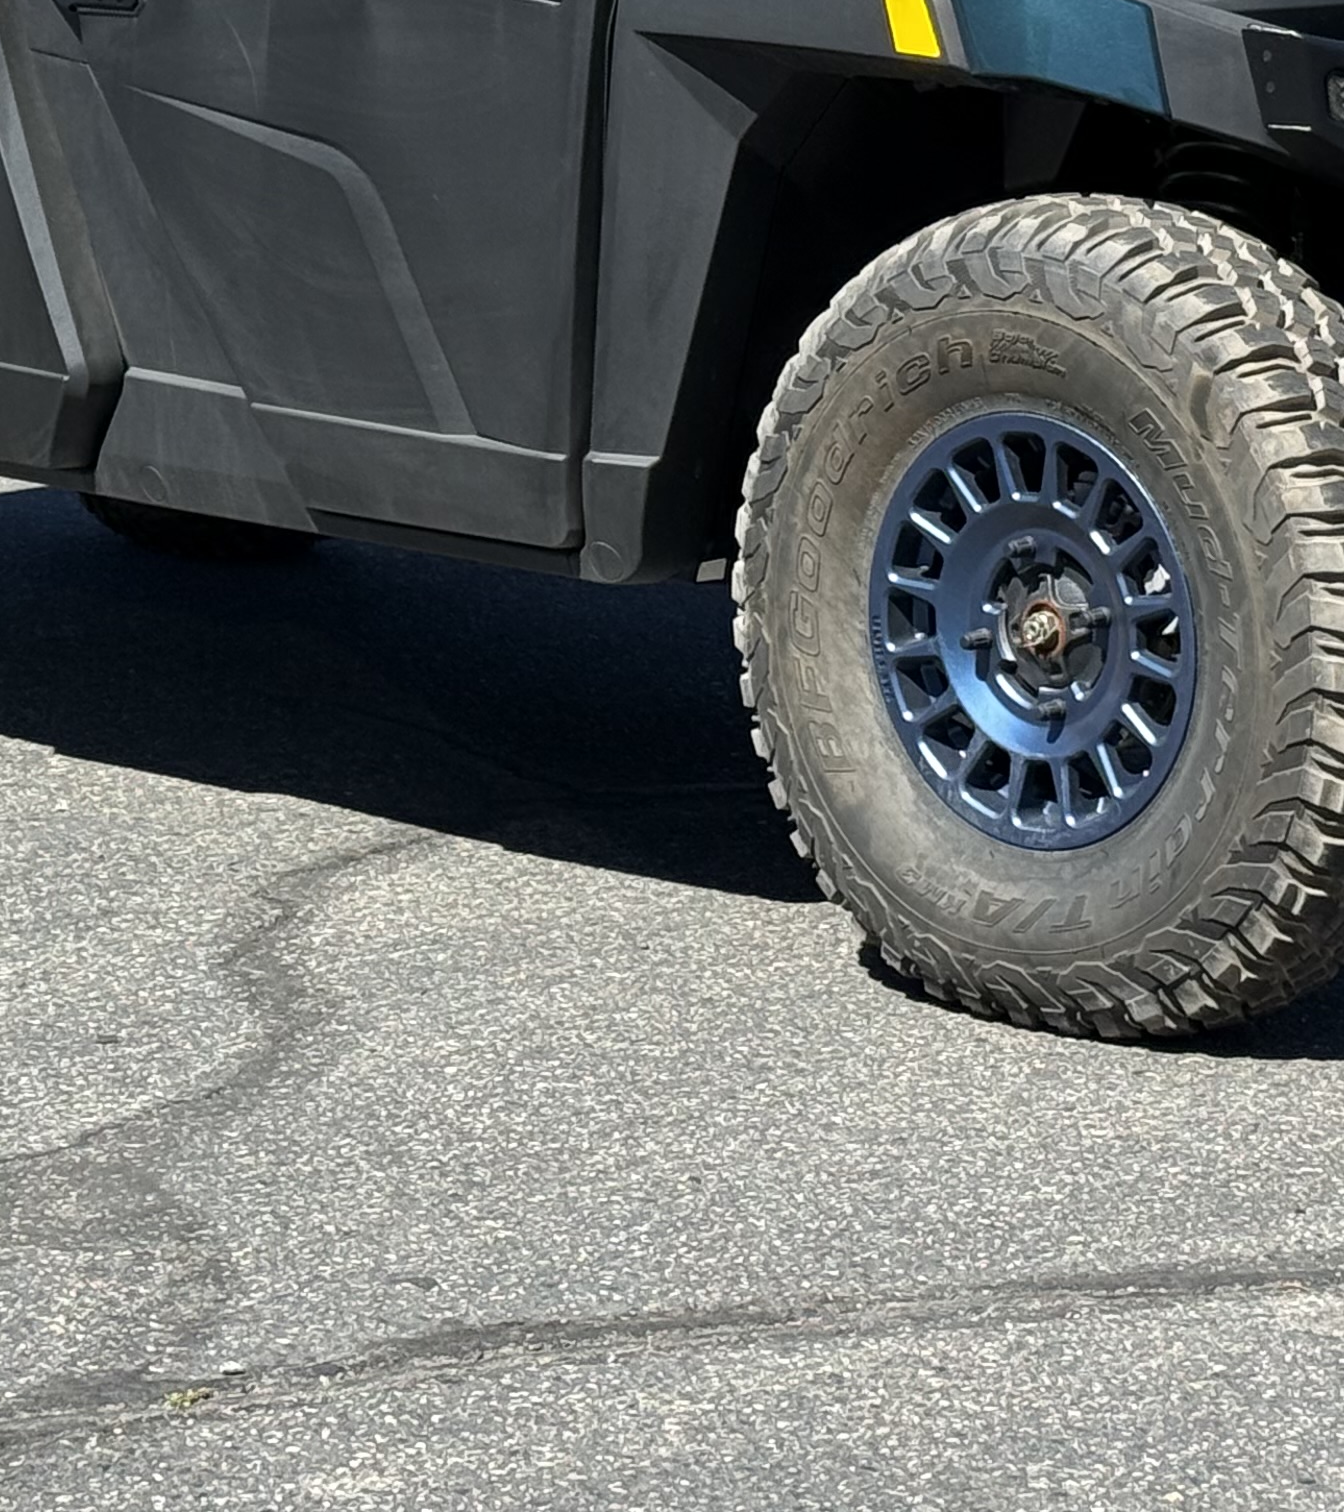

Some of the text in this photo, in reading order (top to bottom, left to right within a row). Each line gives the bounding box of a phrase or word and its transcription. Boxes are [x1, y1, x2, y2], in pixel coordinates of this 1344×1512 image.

[788, 336, 974, 774] BFGoodrich
[1109, 408, 1243, 909] Mud-Terrain
[972, 888, 1093, 935] T/A
